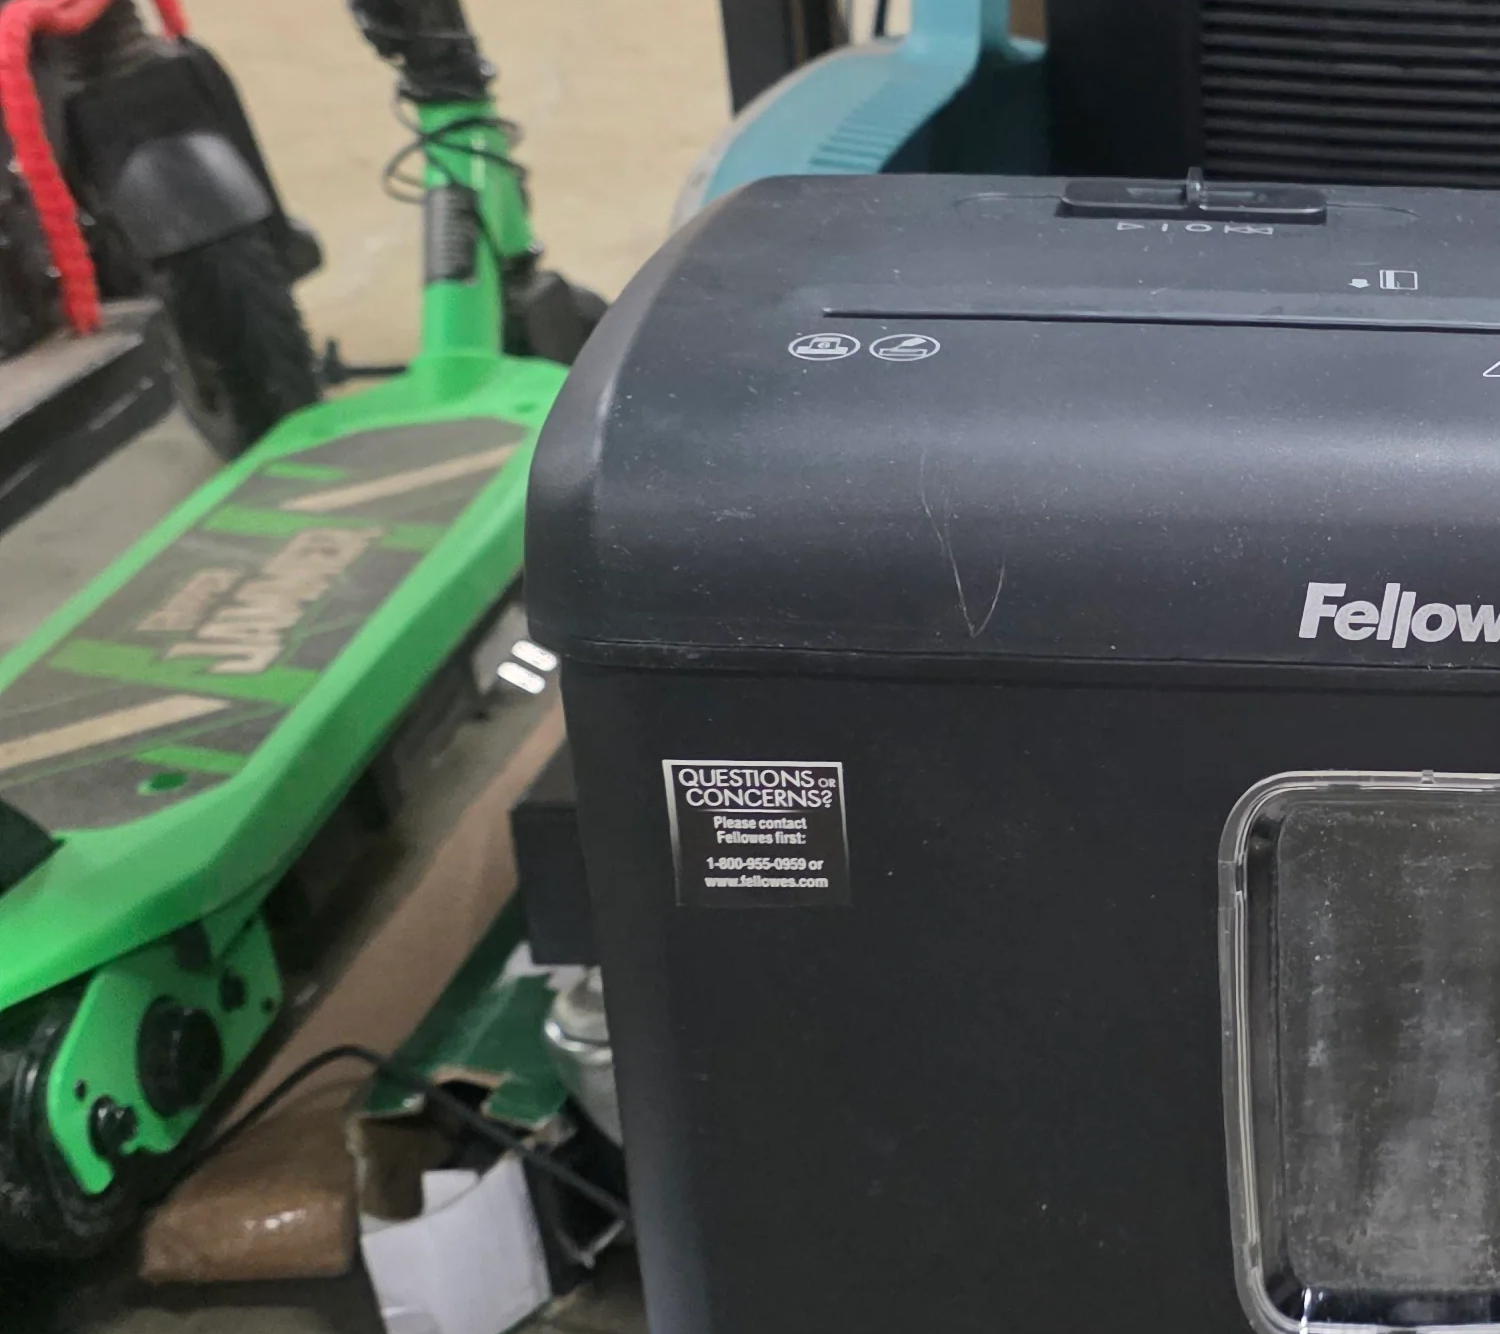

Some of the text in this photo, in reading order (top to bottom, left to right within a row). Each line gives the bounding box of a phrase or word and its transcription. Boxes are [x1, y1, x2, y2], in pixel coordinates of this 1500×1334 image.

[678, 769, 836, 788] QUESTIONS OR
[685, 789, 832, 809] CONCERNS?
[713, 816, 807, 829] Please contact
[717, 831, 806, 845] Fellowes first:
[706, 857, 824, 871] 1-800-955-0959 or
[704, 875, 828, 888] www.fellowes.com
